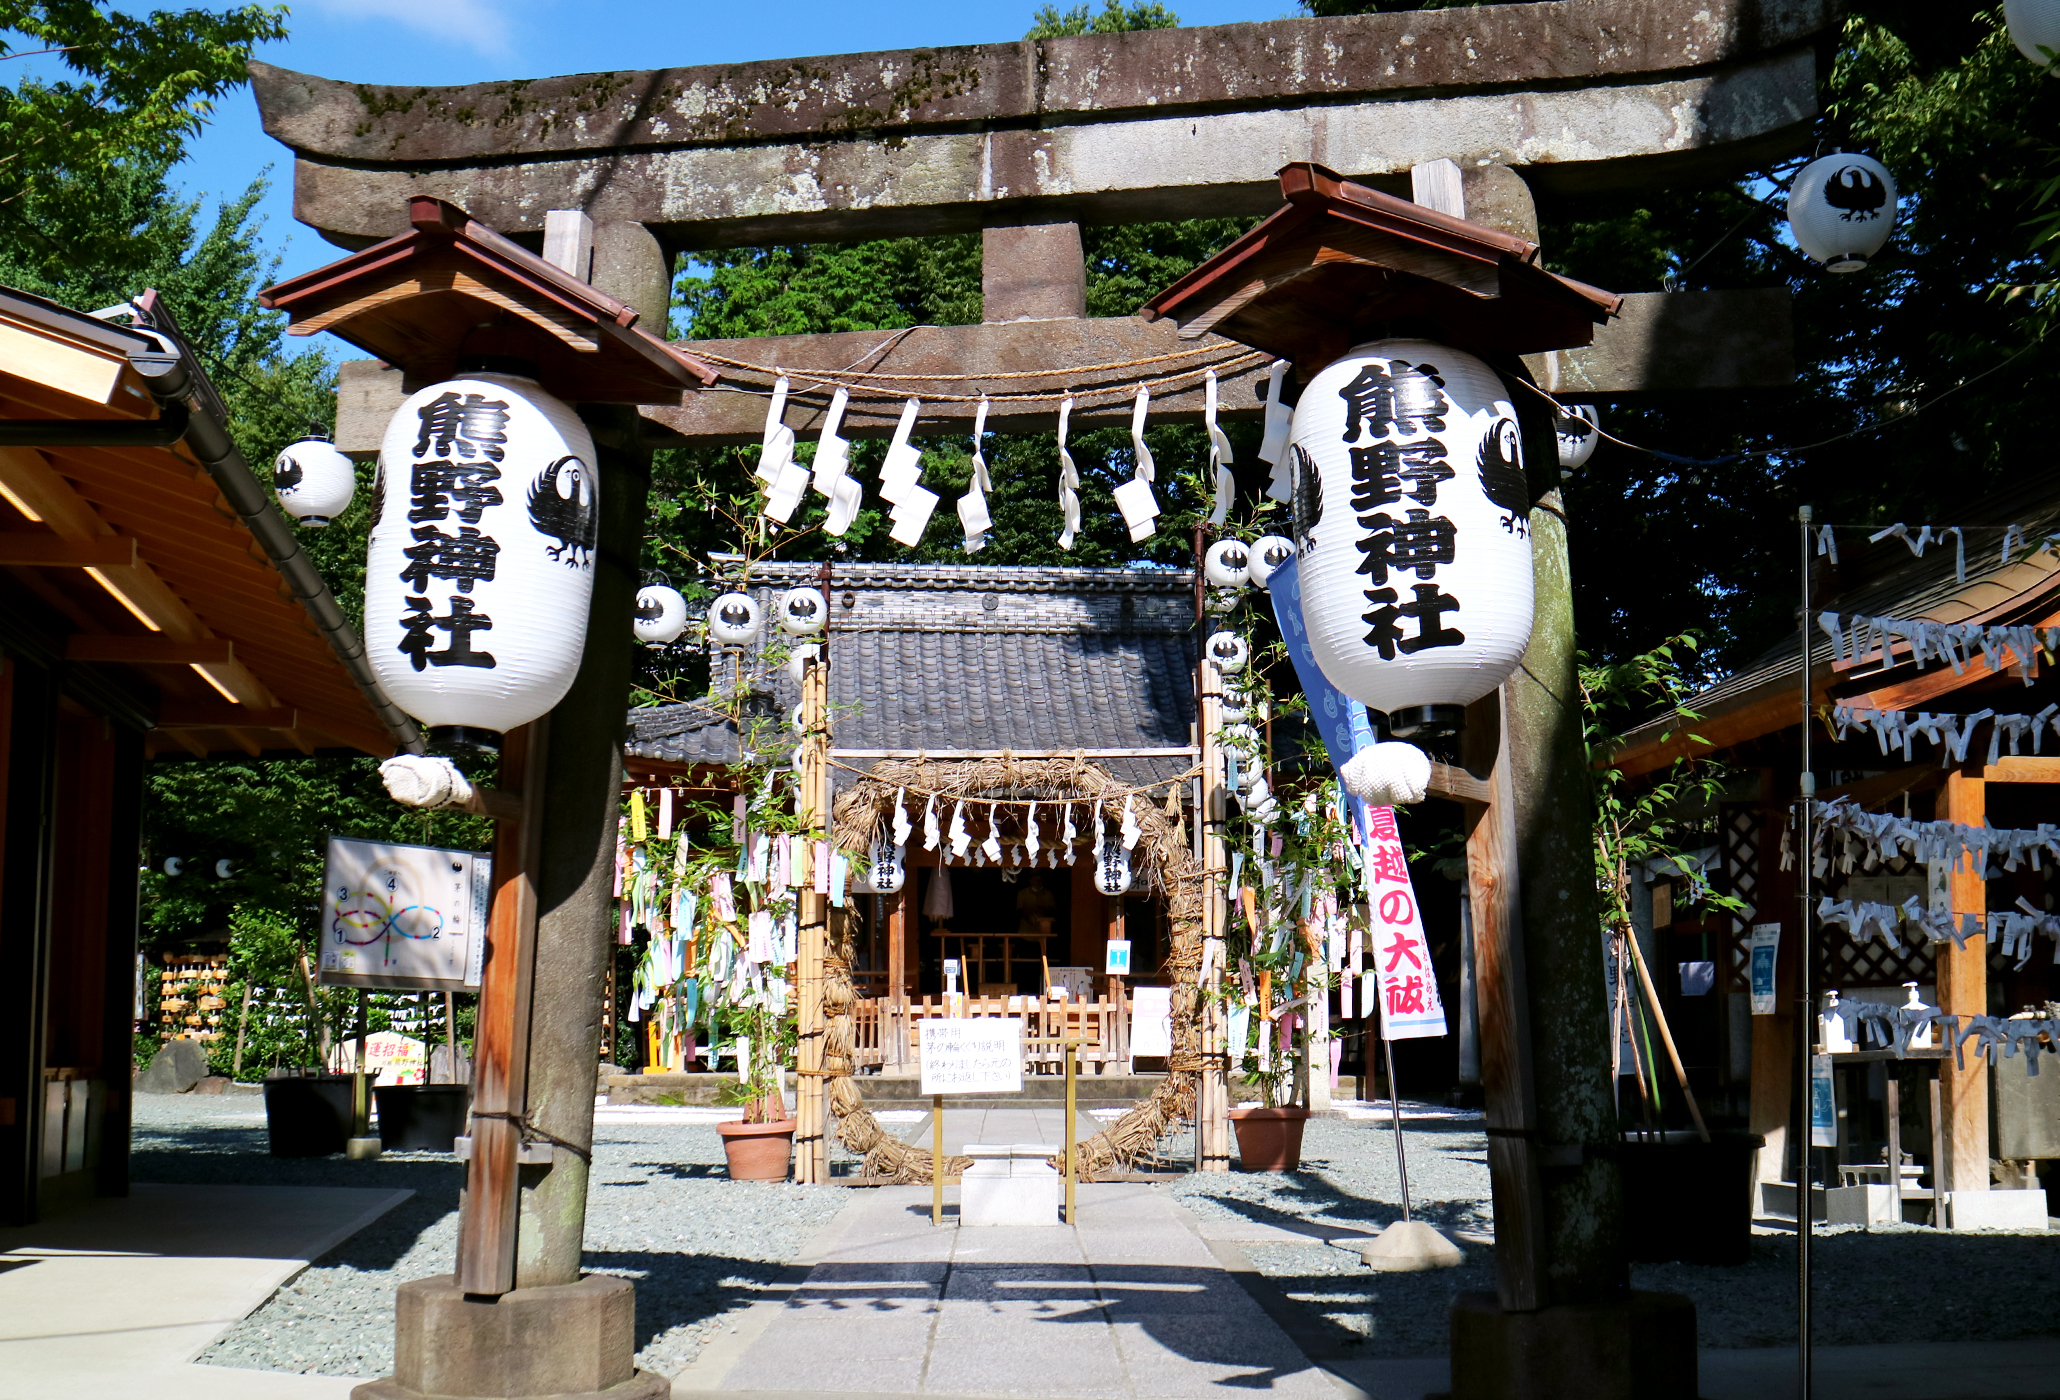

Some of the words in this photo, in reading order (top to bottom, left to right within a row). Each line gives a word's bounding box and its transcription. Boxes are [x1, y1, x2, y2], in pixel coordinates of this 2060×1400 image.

[398, 391, 510, 672] 熊野神社
[1339, 360, 1465, 661] 熊野神社
[1103, 840, 1122, 893] 熊野神社
[1370, 805, 1426, 1016] 夏越の大祓
[365, 1041, 409, 1057] 運招福
[925, 1028, 961, 1040] 携帯用
